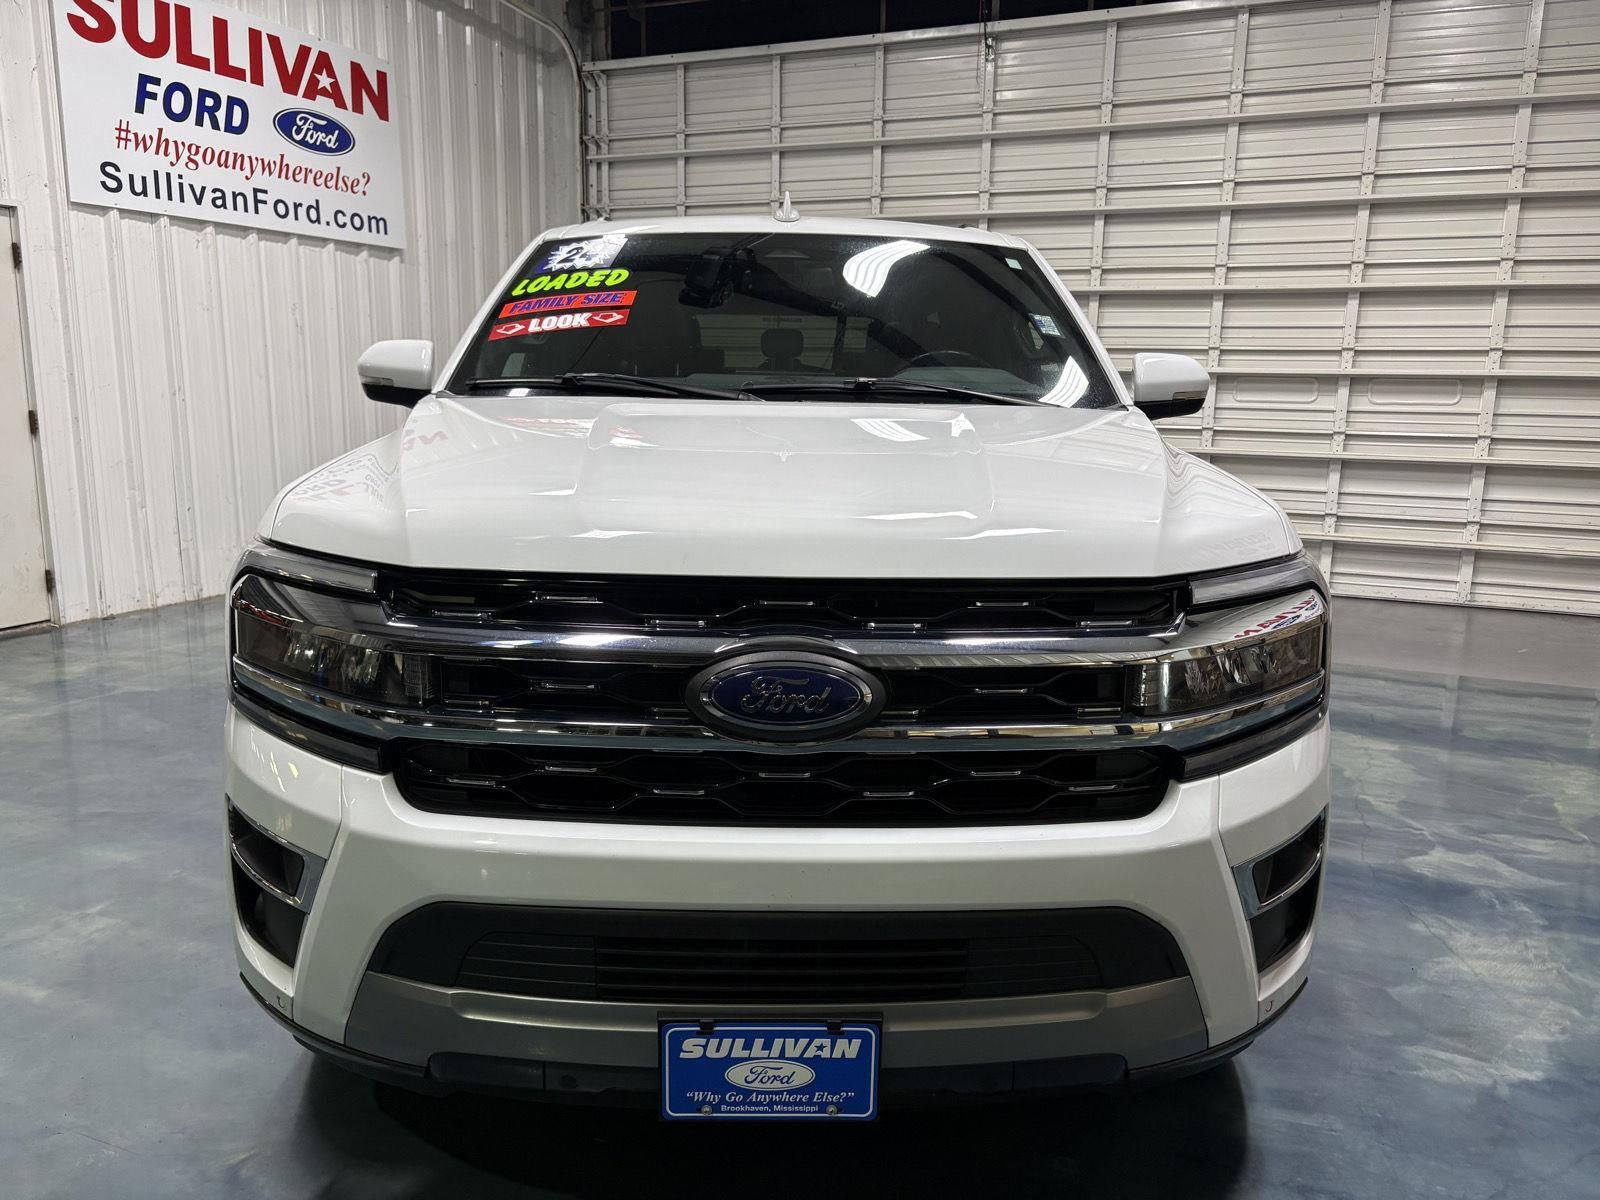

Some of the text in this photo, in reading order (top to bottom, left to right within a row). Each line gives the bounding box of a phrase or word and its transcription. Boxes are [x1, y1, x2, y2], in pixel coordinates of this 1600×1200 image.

[67, 0, 389, 122] SULLIVAN
[134, 73, 249, 135] FORD
[292, 113, 339, 149] Ford
[115, 119, 371, 197] #whygoanywhereelse?
[100, 161, 388, 235] SullivanFord.com
[511, 268, 630, 297] LOADED
[508, 292, 625, 314] FAMILY SIZE
[528, 312, 593, 333] LOOK
[740, 676, 832, 714] Ford
[679, 1038, 862, 1059] SULLIVAN
[744, 1065, 796, 1085] Ford
[720, 1104, 818, 1114] Brookhaven, Mississippi
[725, 1092, 743, 1102] Go
[748, 1092, 809, 1104] Anywhere
